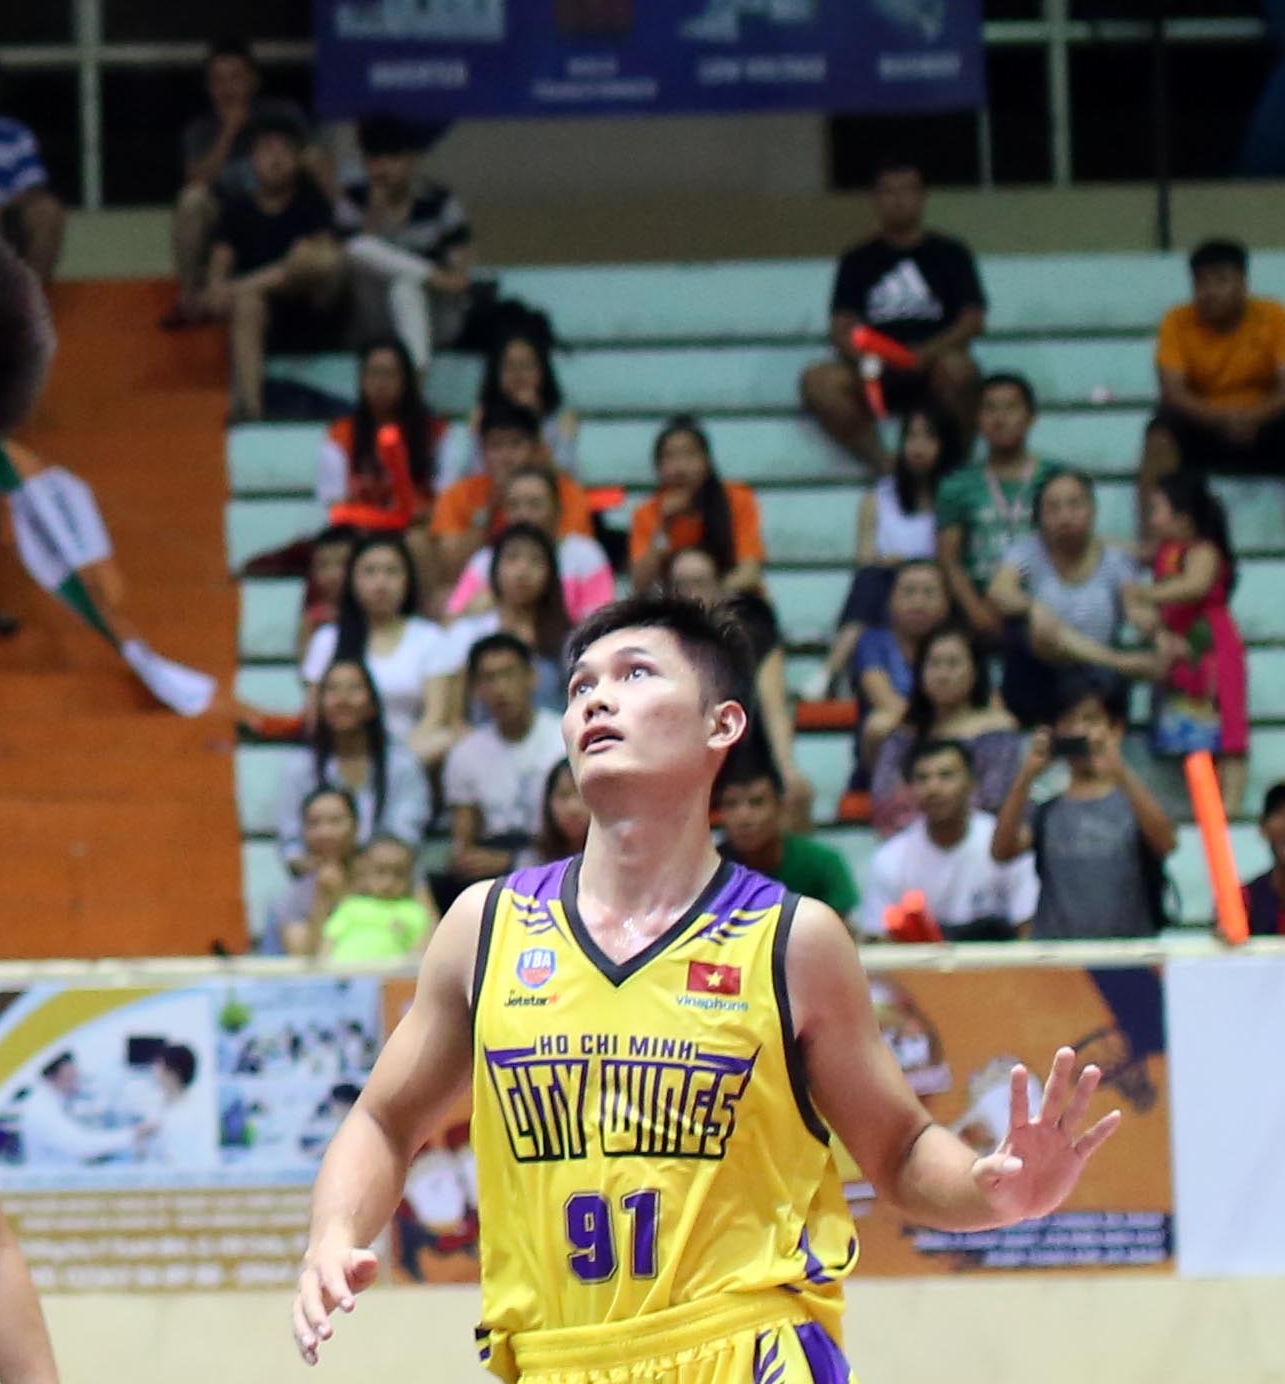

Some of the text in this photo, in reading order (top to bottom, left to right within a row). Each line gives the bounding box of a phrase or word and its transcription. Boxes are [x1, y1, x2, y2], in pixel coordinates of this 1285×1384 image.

[522, 948, 552, 967] VBA
[540, 1034, 693, 1059] HO CHI MINH
[485, 1059, 755, 1163] CITY WINGS
[563, 1188, 662, 1284] 91
